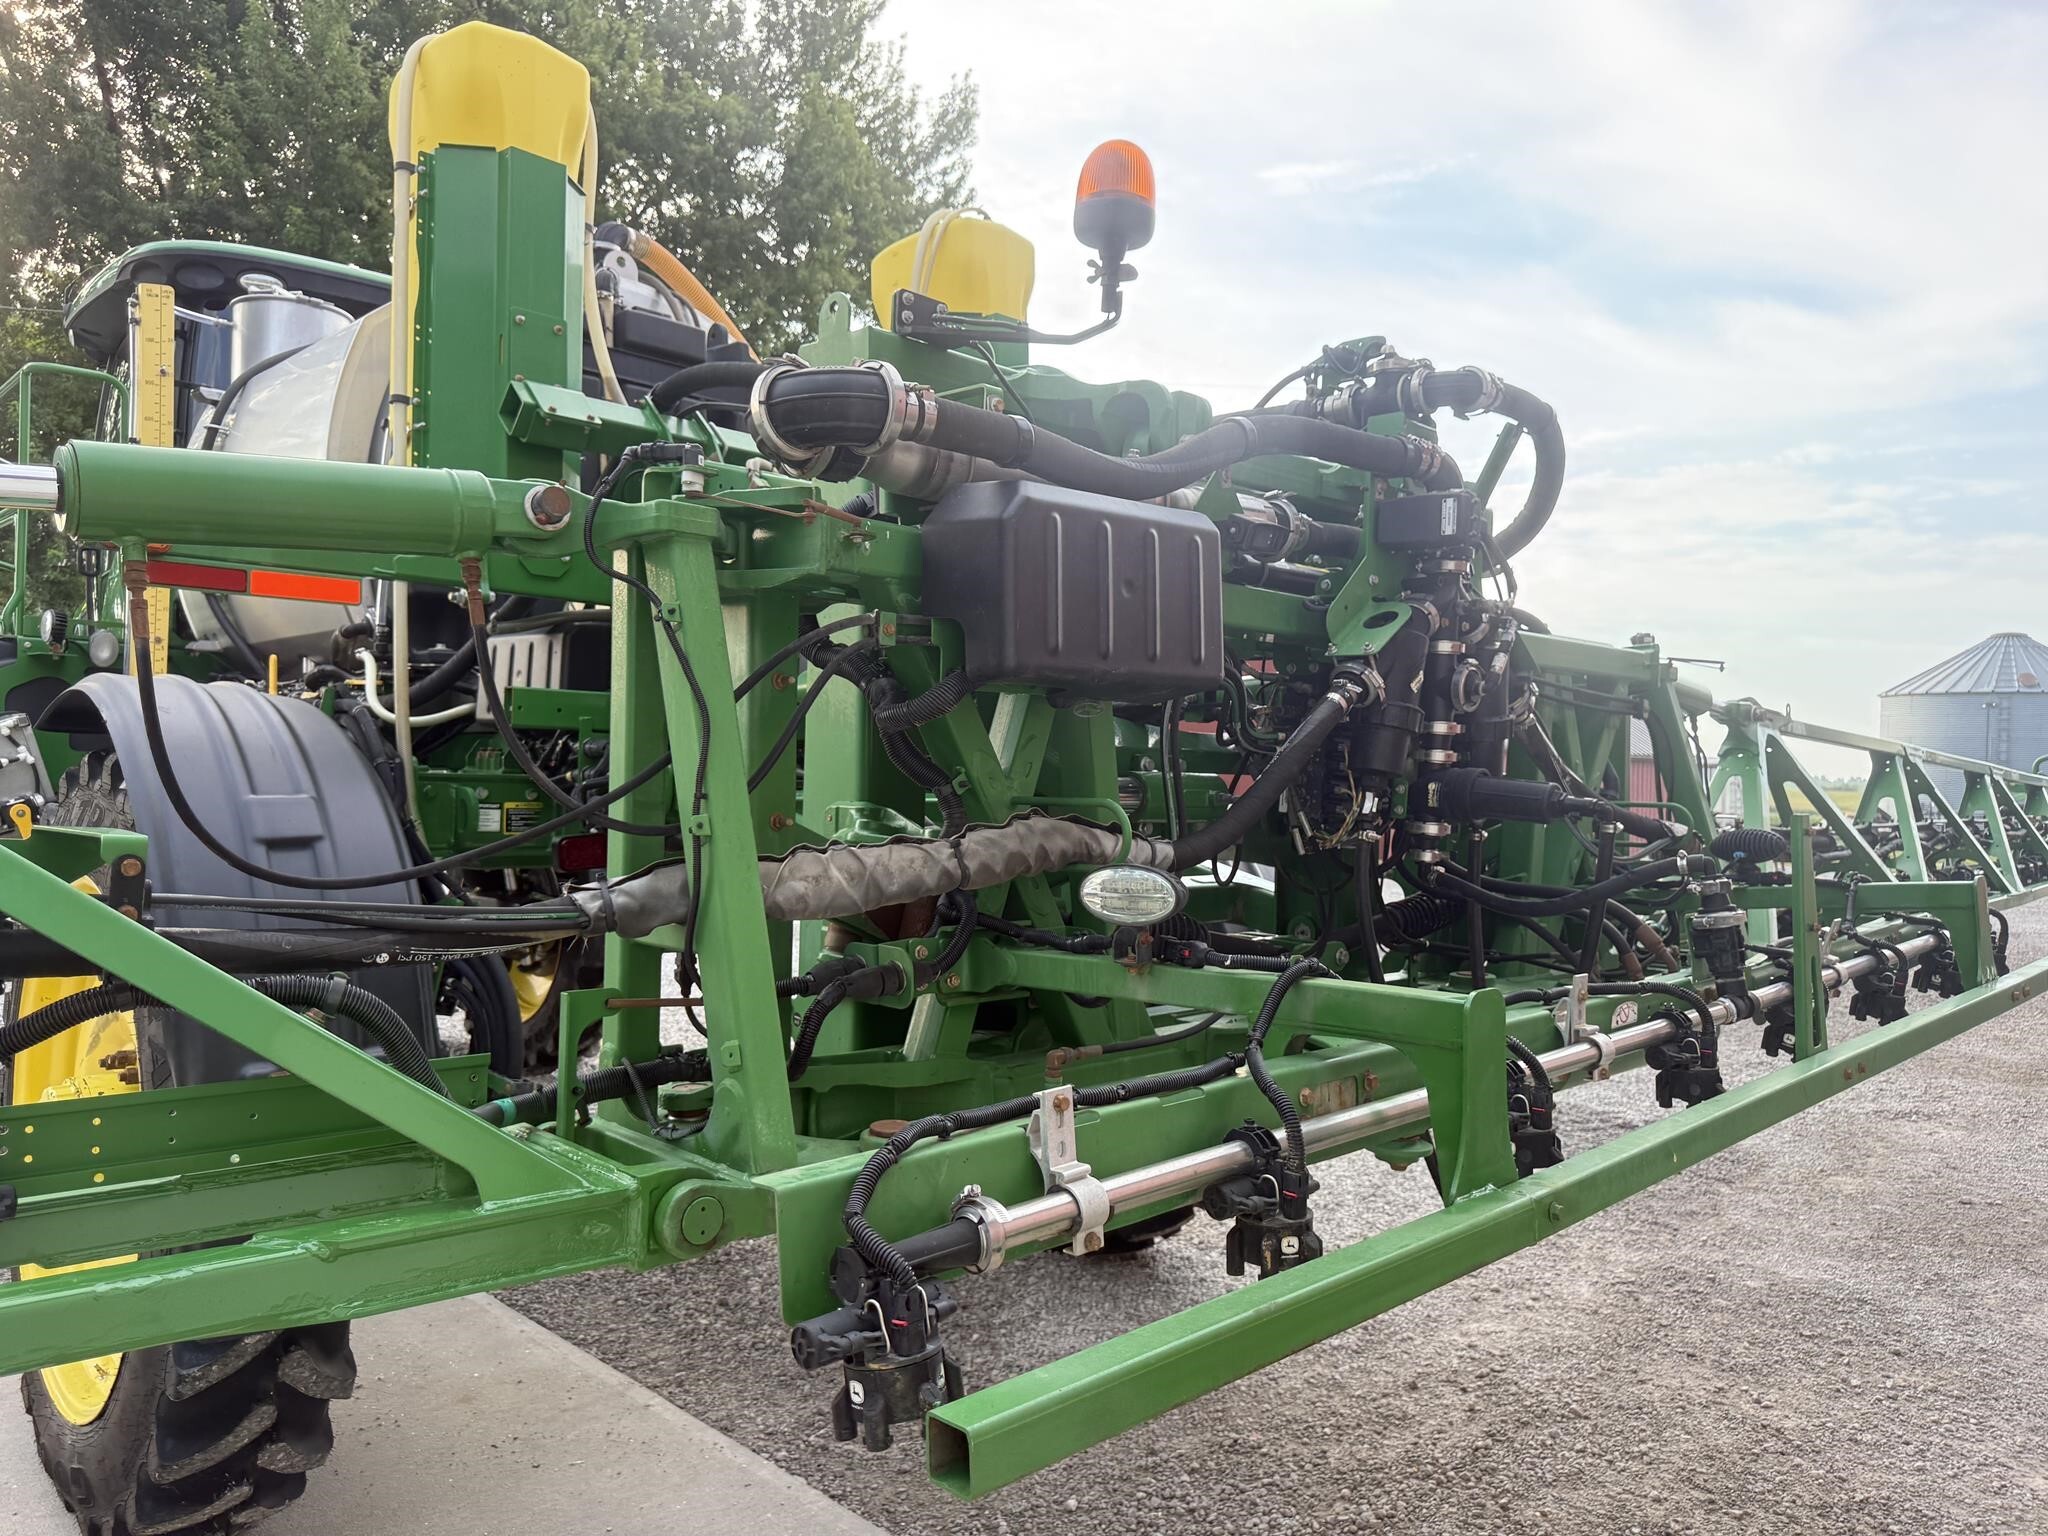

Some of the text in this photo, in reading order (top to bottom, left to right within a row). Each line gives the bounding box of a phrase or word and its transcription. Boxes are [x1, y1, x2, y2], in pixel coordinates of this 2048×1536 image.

[397, 953, 413, 962] PSI
[414, 954, 433, 962] 150
[441, 953, 461, 961] BAR
